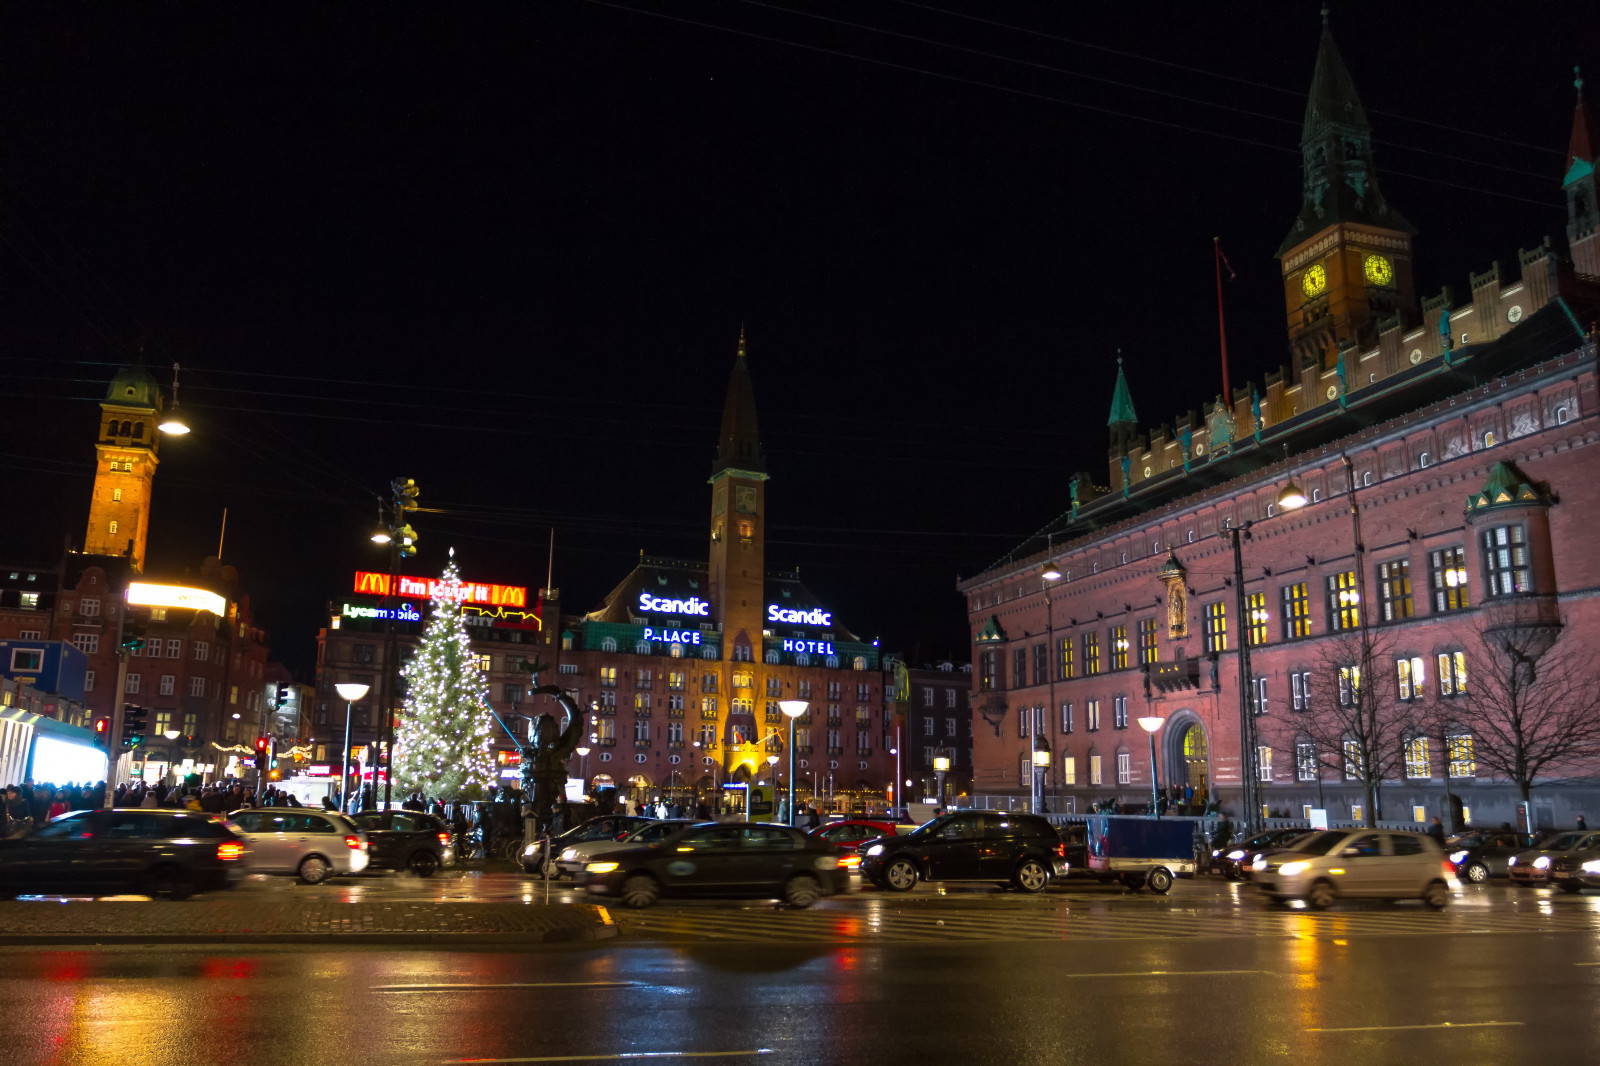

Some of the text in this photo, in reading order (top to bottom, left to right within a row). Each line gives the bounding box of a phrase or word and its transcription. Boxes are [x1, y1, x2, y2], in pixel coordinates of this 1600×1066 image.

[400, 578, 425, 595] i'm
[475, 585, 487, 601] it
[639, 593, 709, 615] Scandic
[465, 615, 495, 628] CITY
[768, 605, 831, 626] Scandic
[783, 639, 834, 655] HOTEL
